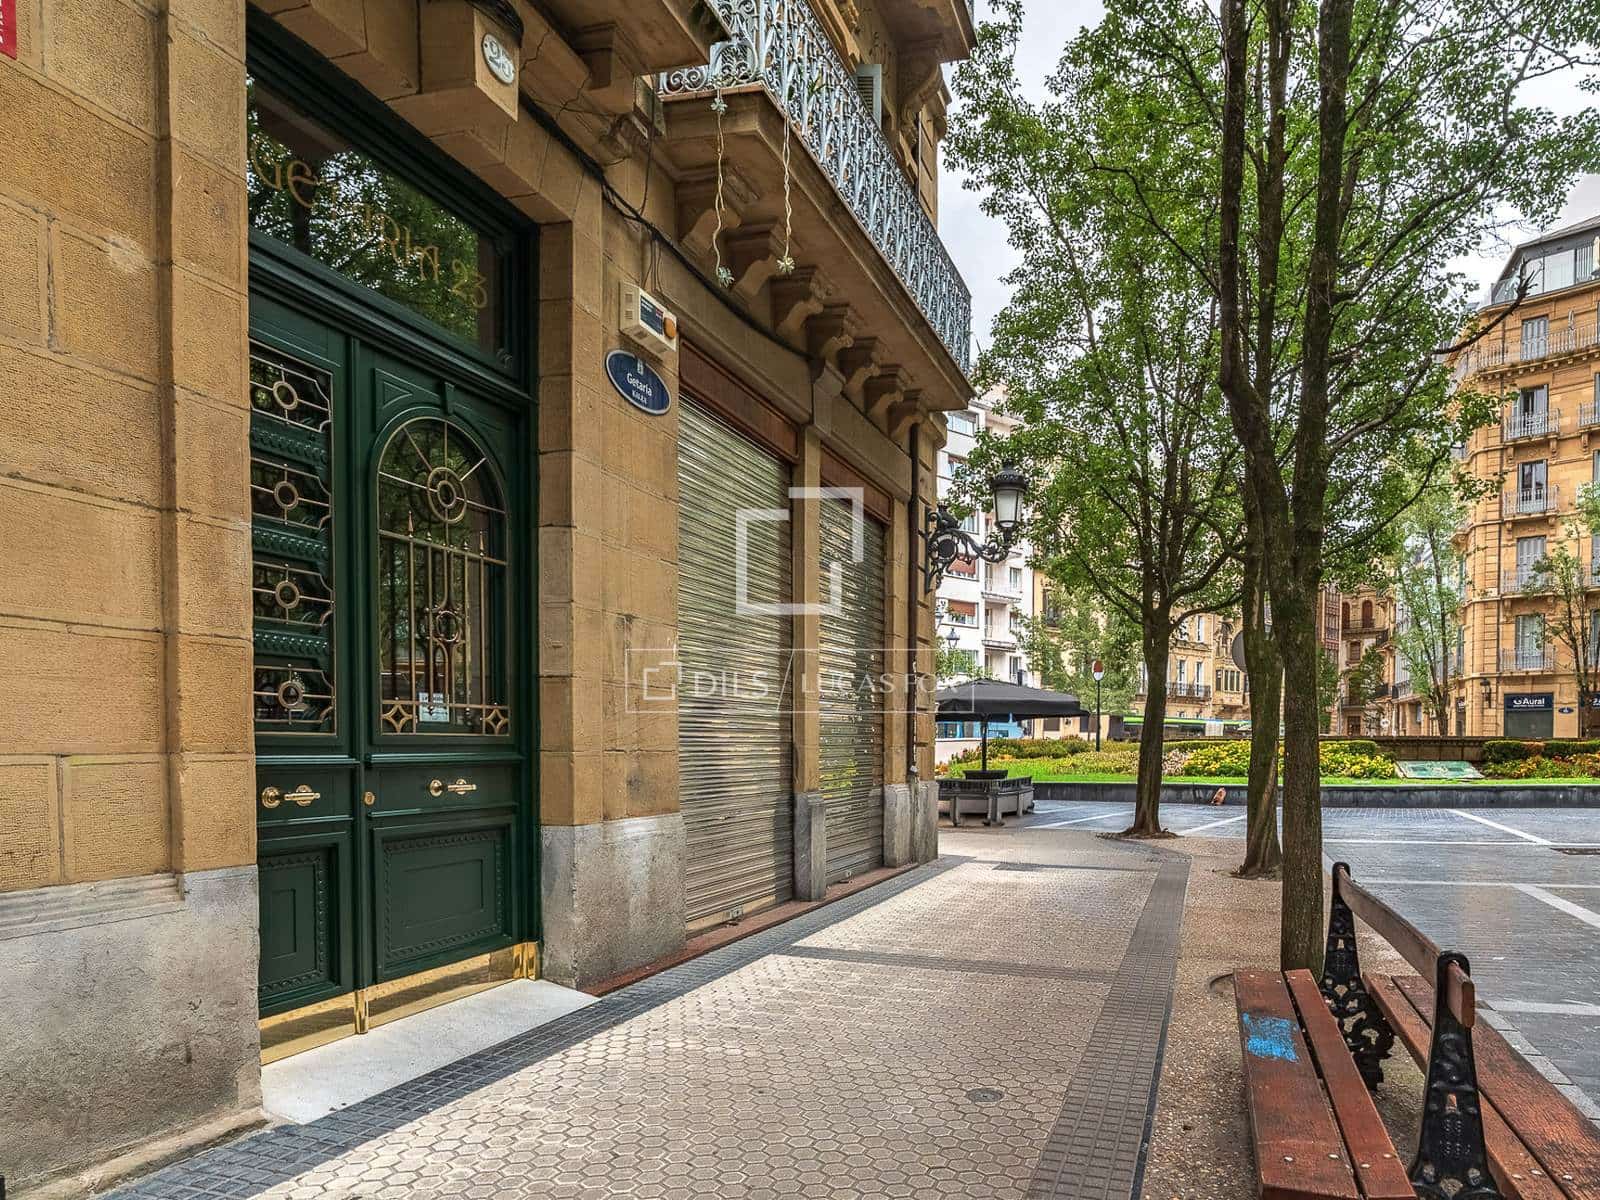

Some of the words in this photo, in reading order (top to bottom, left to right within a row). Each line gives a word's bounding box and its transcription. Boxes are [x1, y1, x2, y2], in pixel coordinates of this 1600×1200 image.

[449, 258, 488, 309] 23
[627, 373, 652, 397] Getaria
[1522, 697, 1545, 705] Aural
